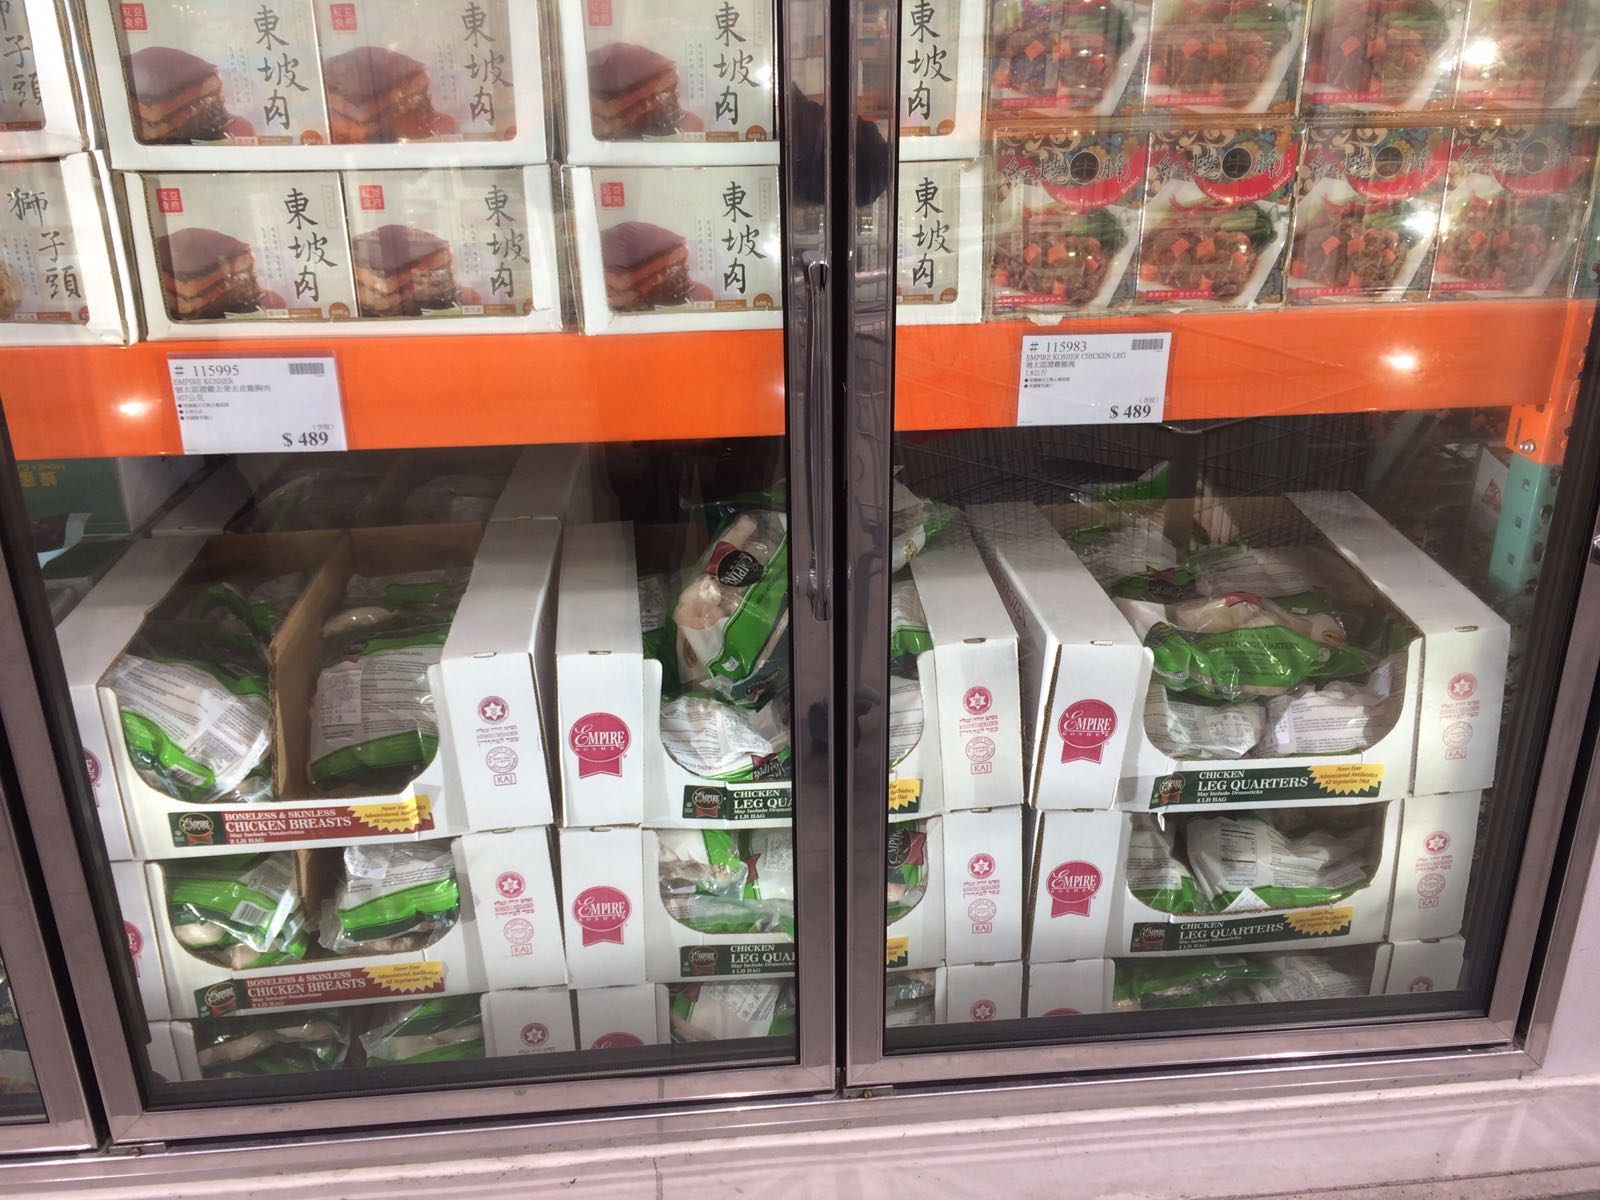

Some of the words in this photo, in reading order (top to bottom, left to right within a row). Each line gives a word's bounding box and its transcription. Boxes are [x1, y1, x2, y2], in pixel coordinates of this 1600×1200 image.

[253, 5, 309, 129] 東坡肉
[461, 2, 513, 126] 東坡肉
[714, 2, 760, 125] 東坡肉
[908, 0, 952, 120] 東坡肉
[484, 185, 530, 297] 東坡肉
[721, 181, 767, 294] 東坡肉
[912, 177, 954, 288] 東坡肉
[7, 188, 81, 299] 獅子頭
[284, 188, 338, 302] 東坡肉
[1029, 340, 1039, 353] #
[1046, 341, 1087, 353] 115983
[1052, 353, 1080, 361] KOSHER
[1080, 352, 1111, 360] CHICKEN
[174, 364, 184, 376] #
[193, 364, 240, 377] 115995
[1109, 405, 1119, 419] $
[1124, 404, 1151, 419] 489
[282, 432, 293, 448] $
[298, 431, 328, 447] 489
[1062, 709, 1112, 733] EMPIRE
[574, 723, 625, 748] EMPIRE
[1199, 770, 1245, 779] CHICKEN
[1198, 781, 1227, 792] LEG
[1230, 776, 1308, 791] QUARTERS
[733, 789, 780, 798] CHICKEN
[734, 798, 763, 809] LEG
[225, 811, 276, 821] BONELESS
[278, 810, 286, 818] &
[288, 809, 336, 819] SKINLESS
[225, 819, 287, 833] CHICKEN
[290, 817, 351, 831] BREASTS
[1051, 869, 1096, 891] EMPIRE
[577, 896, 625, 917] EMPIRE
[1179, 930, 1206, 939] LEG
[1210, 922, 1284, 938] QUARTERS
[1180, 921, 1224, 930] CHICKEN
[731, 944, 774, 952] CHICKEN
[731, 953, 760, 963] LEG
[246, 976, 297, 987] BONELESS
[298, 975, 305, 983] &
[306, 971, 351, 981] SKINLESS
[248, 984, 305, 999] CHICKEN
[308, 978, 366, 993] BREASTS
